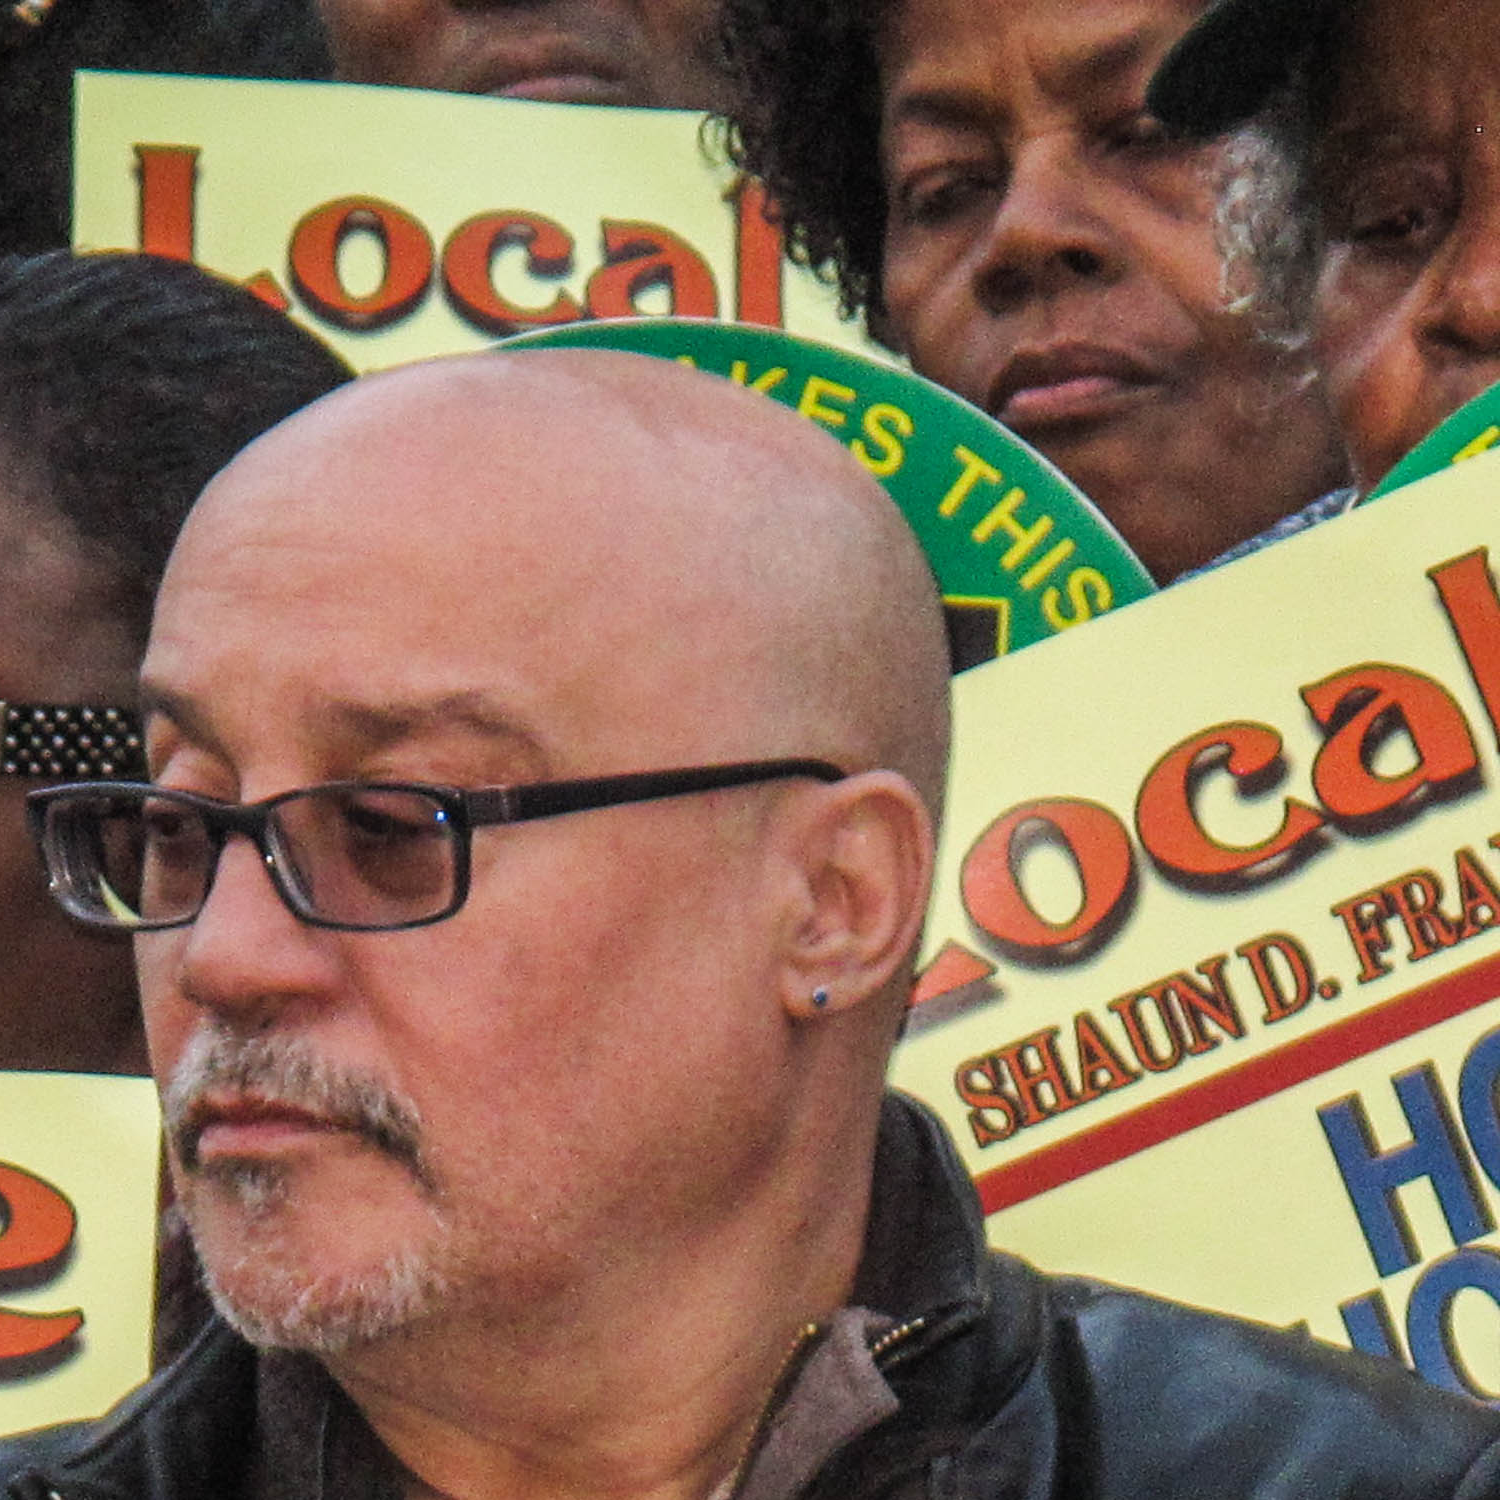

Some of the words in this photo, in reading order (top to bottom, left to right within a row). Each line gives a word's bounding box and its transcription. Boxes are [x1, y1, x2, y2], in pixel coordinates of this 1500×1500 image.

[937, 443, 1116, 631] THIS
[953, 951, 1246, 1150] SHAUN
[1237, 930, 1342, 1028] D.
